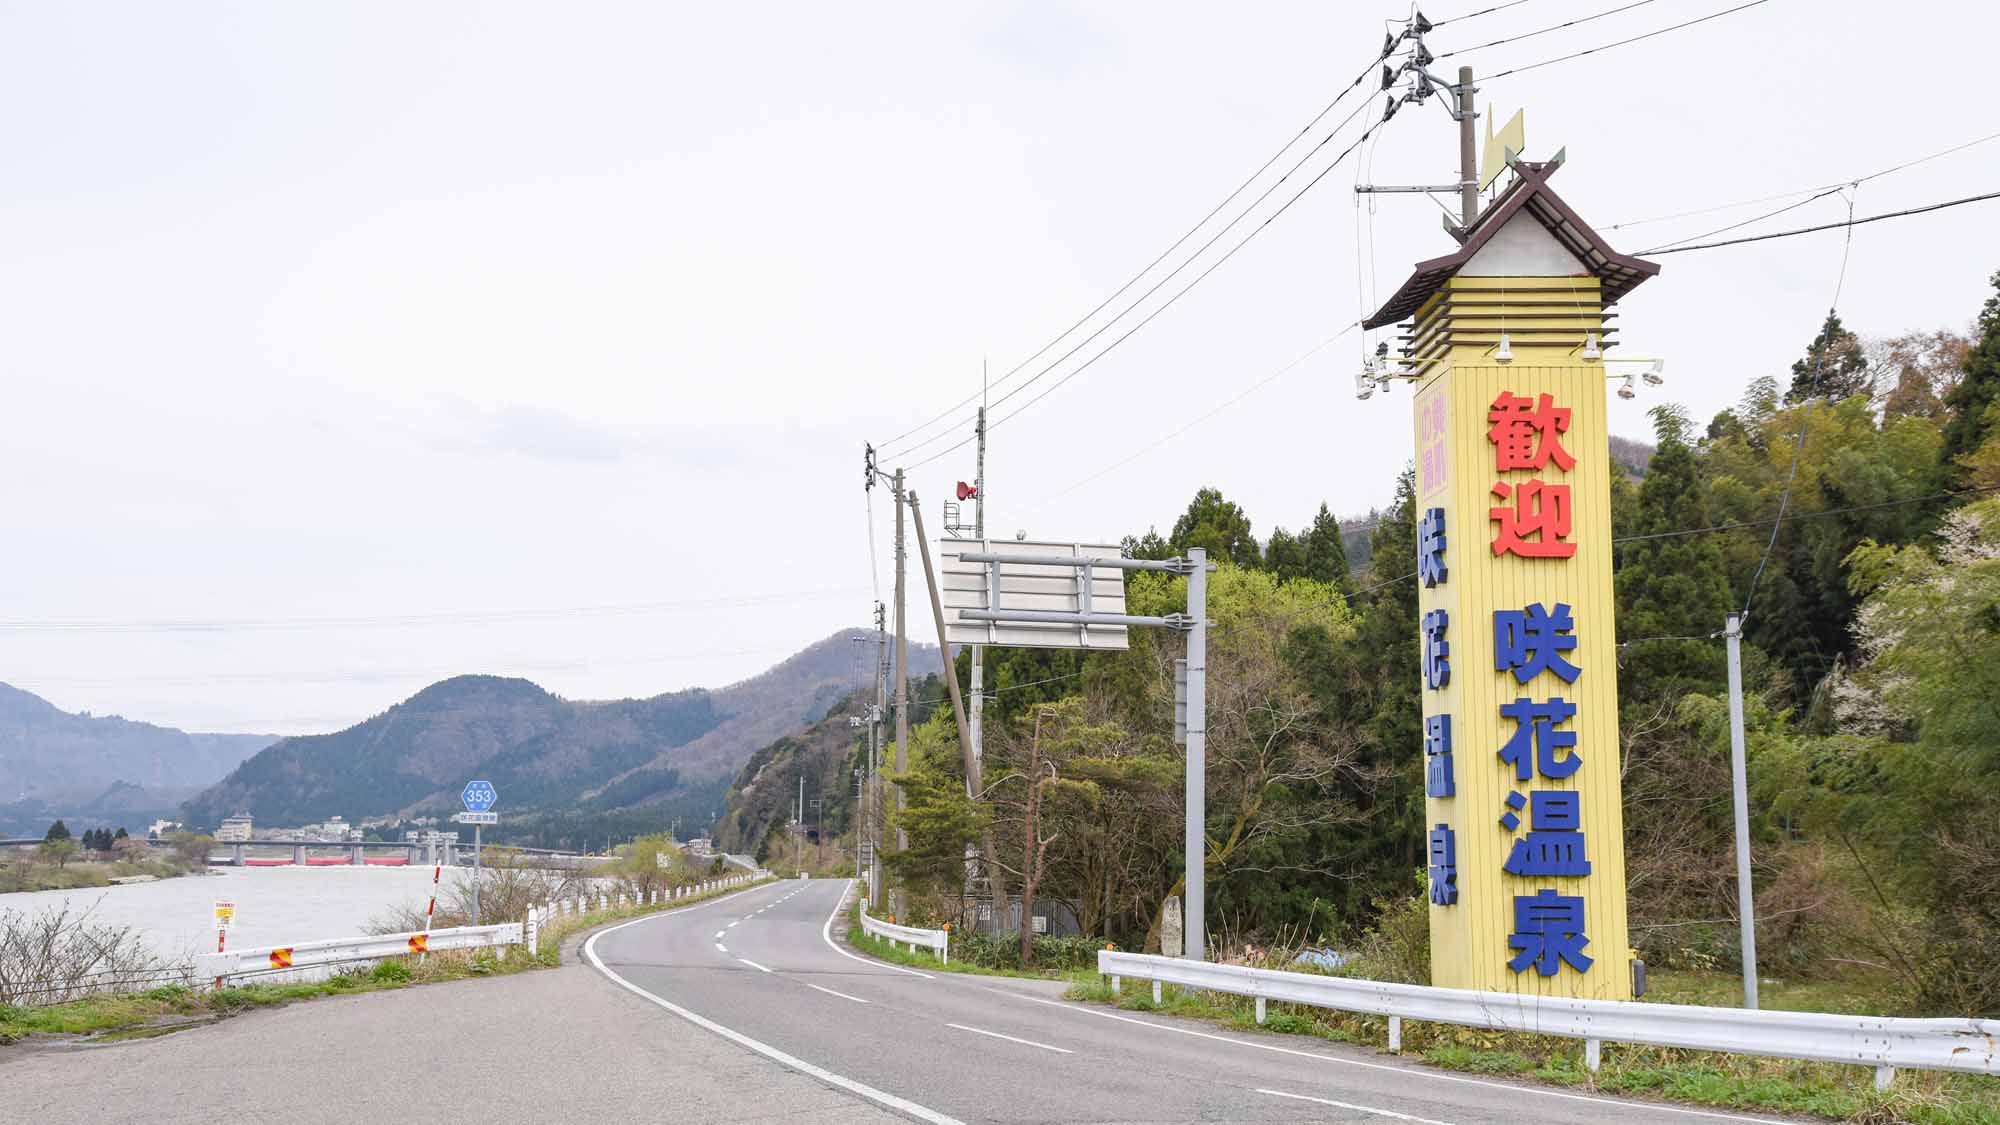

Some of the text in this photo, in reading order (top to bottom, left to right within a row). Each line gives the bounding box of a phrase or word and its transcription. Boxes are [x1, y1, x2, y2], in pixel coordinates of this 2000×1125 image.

[1487, 390, 1578, 559] 歓迎
[467, 789, 491, 802] 353
[1418, 507, 1458, 906] 咲花温泉
[1493, 602, 1595, 977] 咲花温泉
